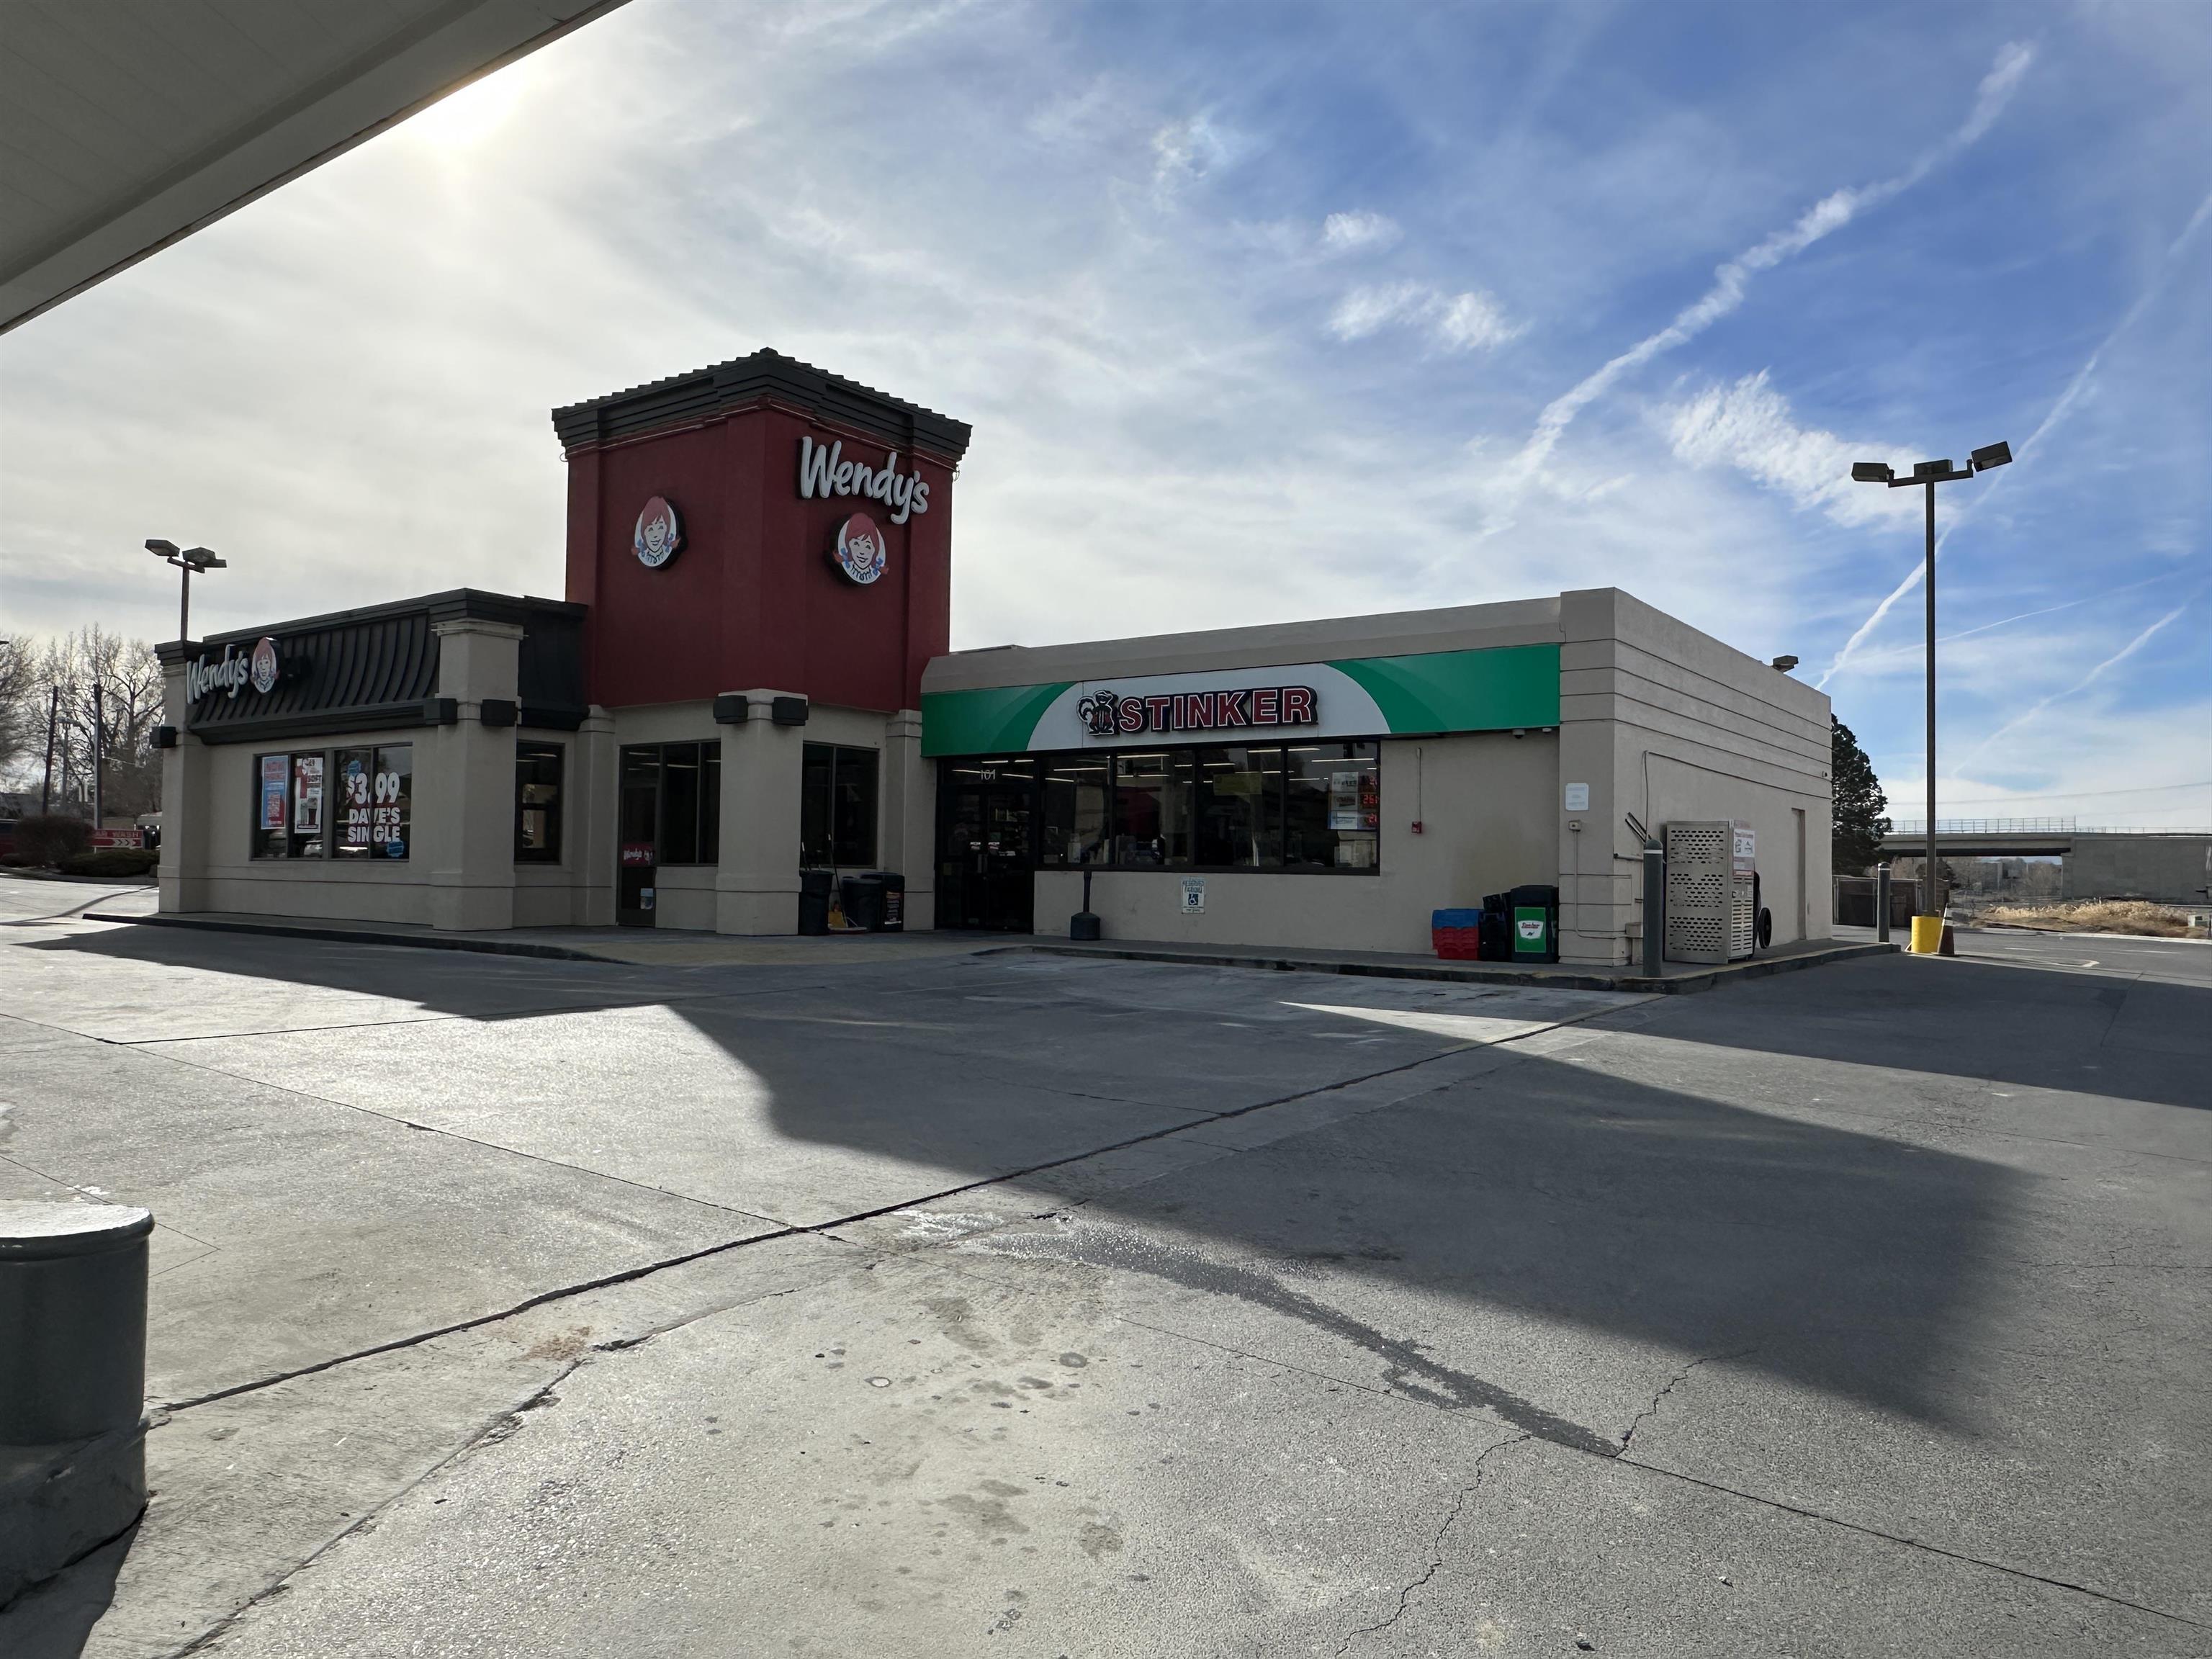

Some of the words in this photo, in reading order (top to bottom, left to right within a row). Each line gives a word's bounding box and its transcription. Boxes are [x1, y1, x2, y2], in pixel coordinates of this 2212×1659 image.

[801, 436, 930, 525] Wendy's
[186, 644, 249, 704] Wendy's
[1118, 686, 1313, 733] STINKER
[347, 825, 400, 843] SINGLE
[349, 807, 400, 824] DAVE'S
